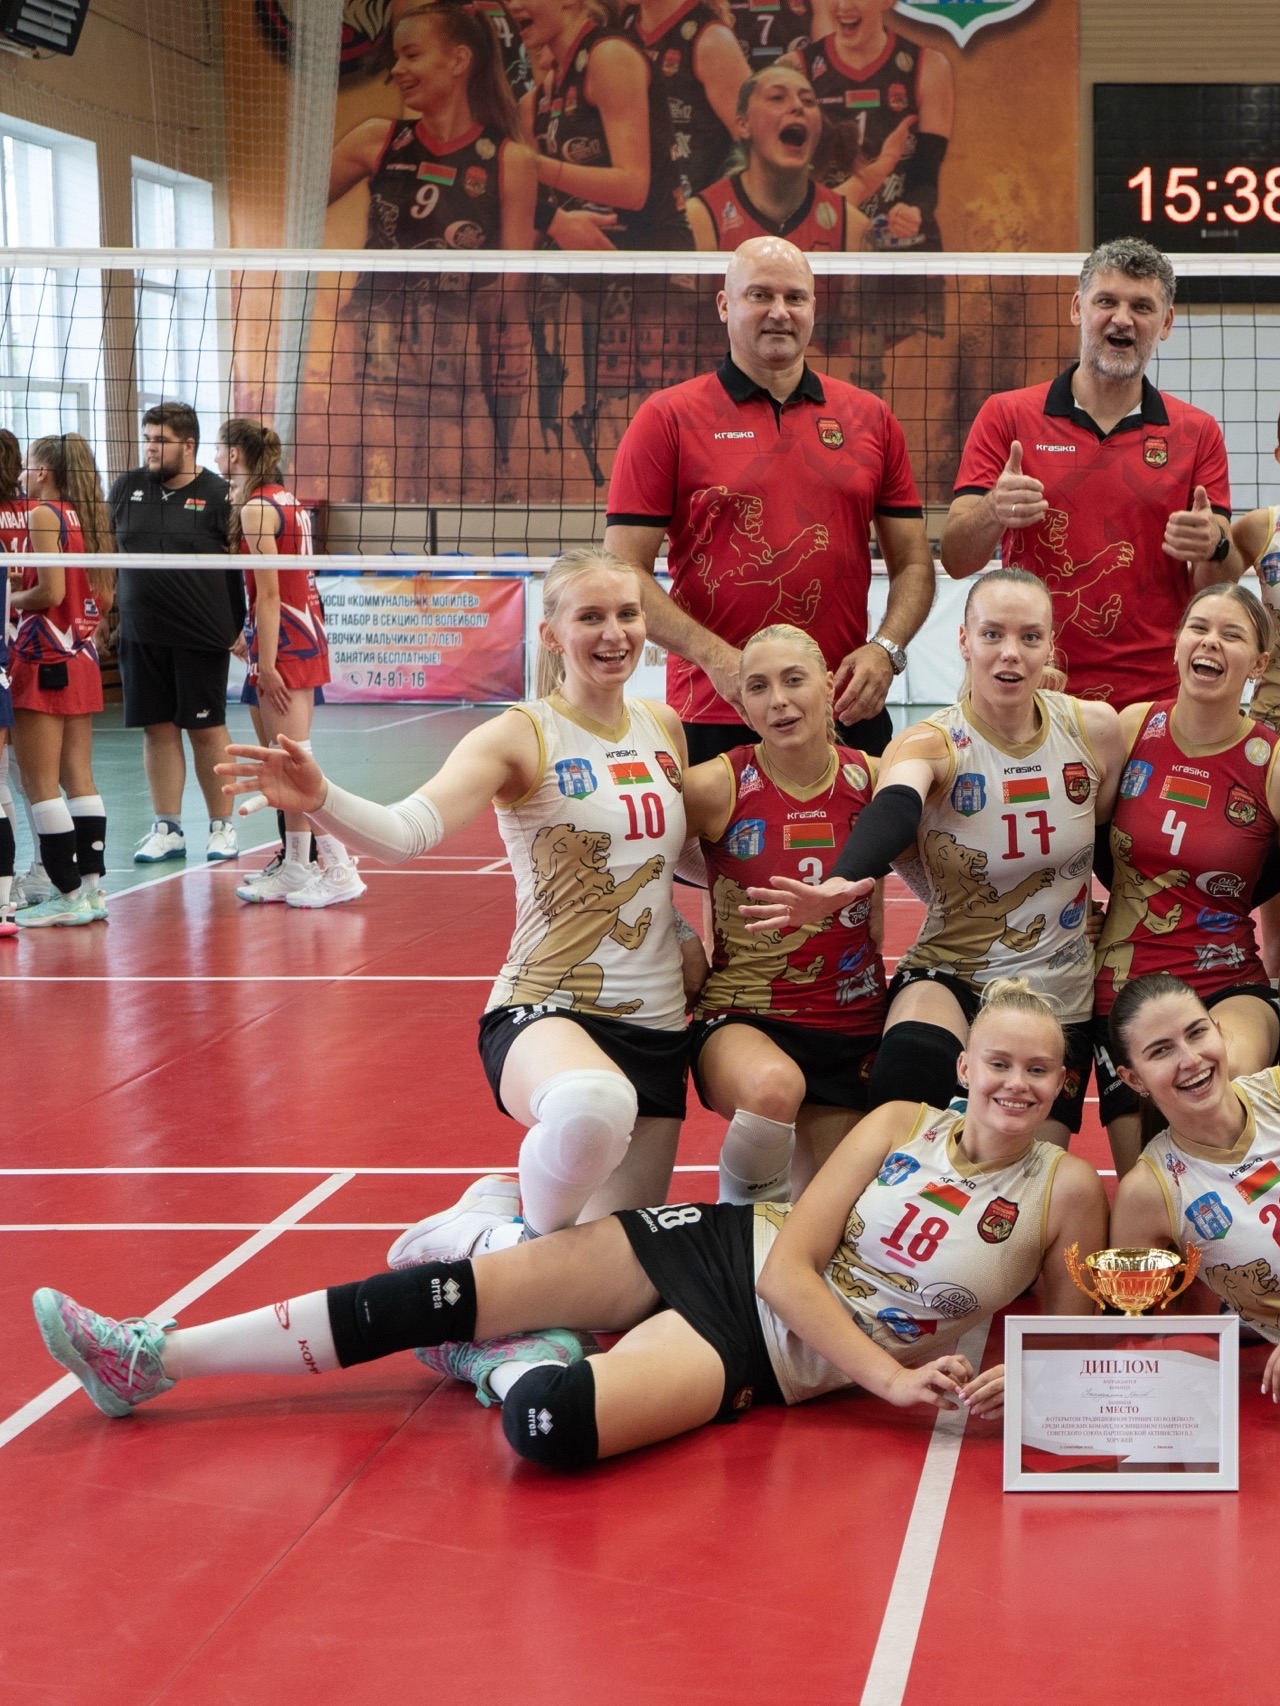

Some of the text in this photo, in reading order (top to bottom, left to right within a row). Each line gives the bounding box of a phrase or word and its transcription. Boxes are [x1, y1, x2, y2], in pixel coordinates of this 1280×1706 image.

[757, 15, 775, 45] 7
[410, 184, 440, 219] 9
[341, 614, 371, 626] НАБОР
[373, 614, 378, 626] В
[380, 614, 419, 628] СЕКЦИЮ
[421, 614, 433, 626] ПО
[435, 611, 489, 627] ВОЛЕЙБОЛУ
[418, 634, 429, 645] ОТ
[335, 651, 441, 664] ЗАНЯТИЯ БЕСПЛАТНЫЕ!
[367, 672, 425, 688] 74-81-16
[619, 792, 666, 841] 10
[1001, 809, 1057, 860] 17
[1161, 809, 1187, 856] 4
[880, 1202, 950, 1262] 18
[431, 1278, 443, 1309] errea
[1079, 1359, 1160, 1376] ДИПЛОМ
[528, 1408, 537, 1437] errea
[1105, 1406, 1140, 1414] МЕСТО
